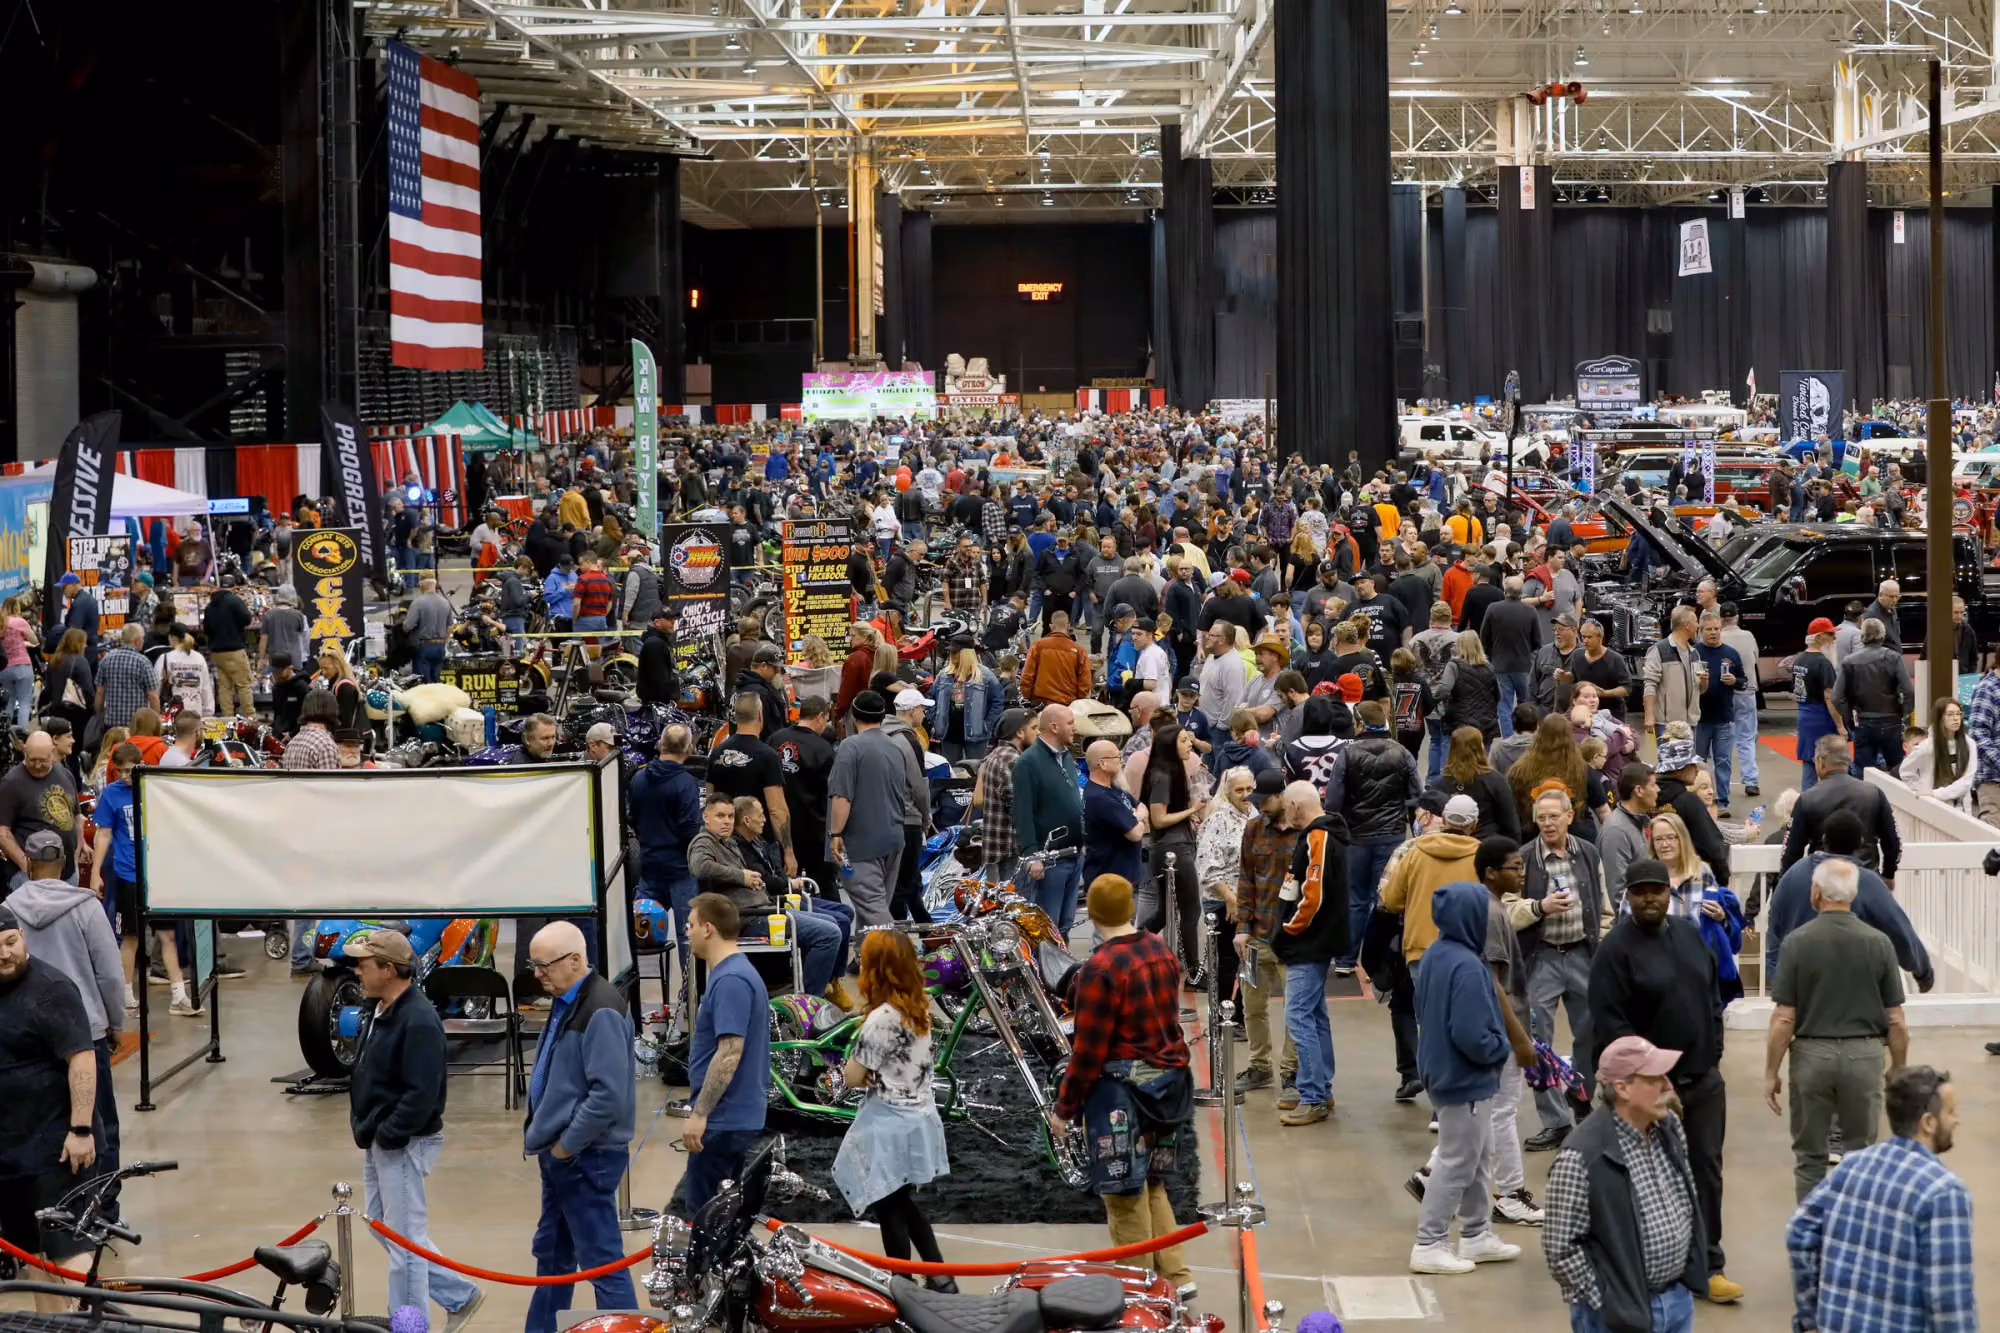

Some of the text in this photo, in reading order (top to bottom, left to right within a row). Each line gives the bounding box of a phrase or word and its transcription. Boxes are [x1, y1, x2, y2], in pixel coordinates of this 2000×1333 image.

[1018, 283, 1063, 292] EMERGENCY
[1031, 291, 1049, 300] EXIT
[1588, 365, 1629, 373] CarCapsule
[961, 379, 986, 388] GYROS
[952, 393, 999, 404] GYROS
[1799, 378, 1810, 420] Twisted
[71, 538, 110, 555] STEP UP
[303, 533, 352, 550] COMBAT VETS
[784, 544, 850, 563] WIN $500
[304, 559, 352, 574] ASSOCIATION
[785, 565, 805, 573] STEP
[808, 565, 825, 573] LIKE
[836, 564, 848, 572] ON
[789, 573, 802, 588] 1.
[808, 571, 848, 581] FACEBOOK.
[786, 589, 806, 598] STEP
[682, 601, 711, 617] OHIO'S
[789, 598, 803, 613] 2.
[310, 576, 355, 656] CVMA
[786, 616, 806, 625] STEP
[790, 624, 804, 639] 3.
[787, 652, 806, 660] STE
[461, 674, 497, 690] RUN
[1301, 752, 1339, 784] 38
